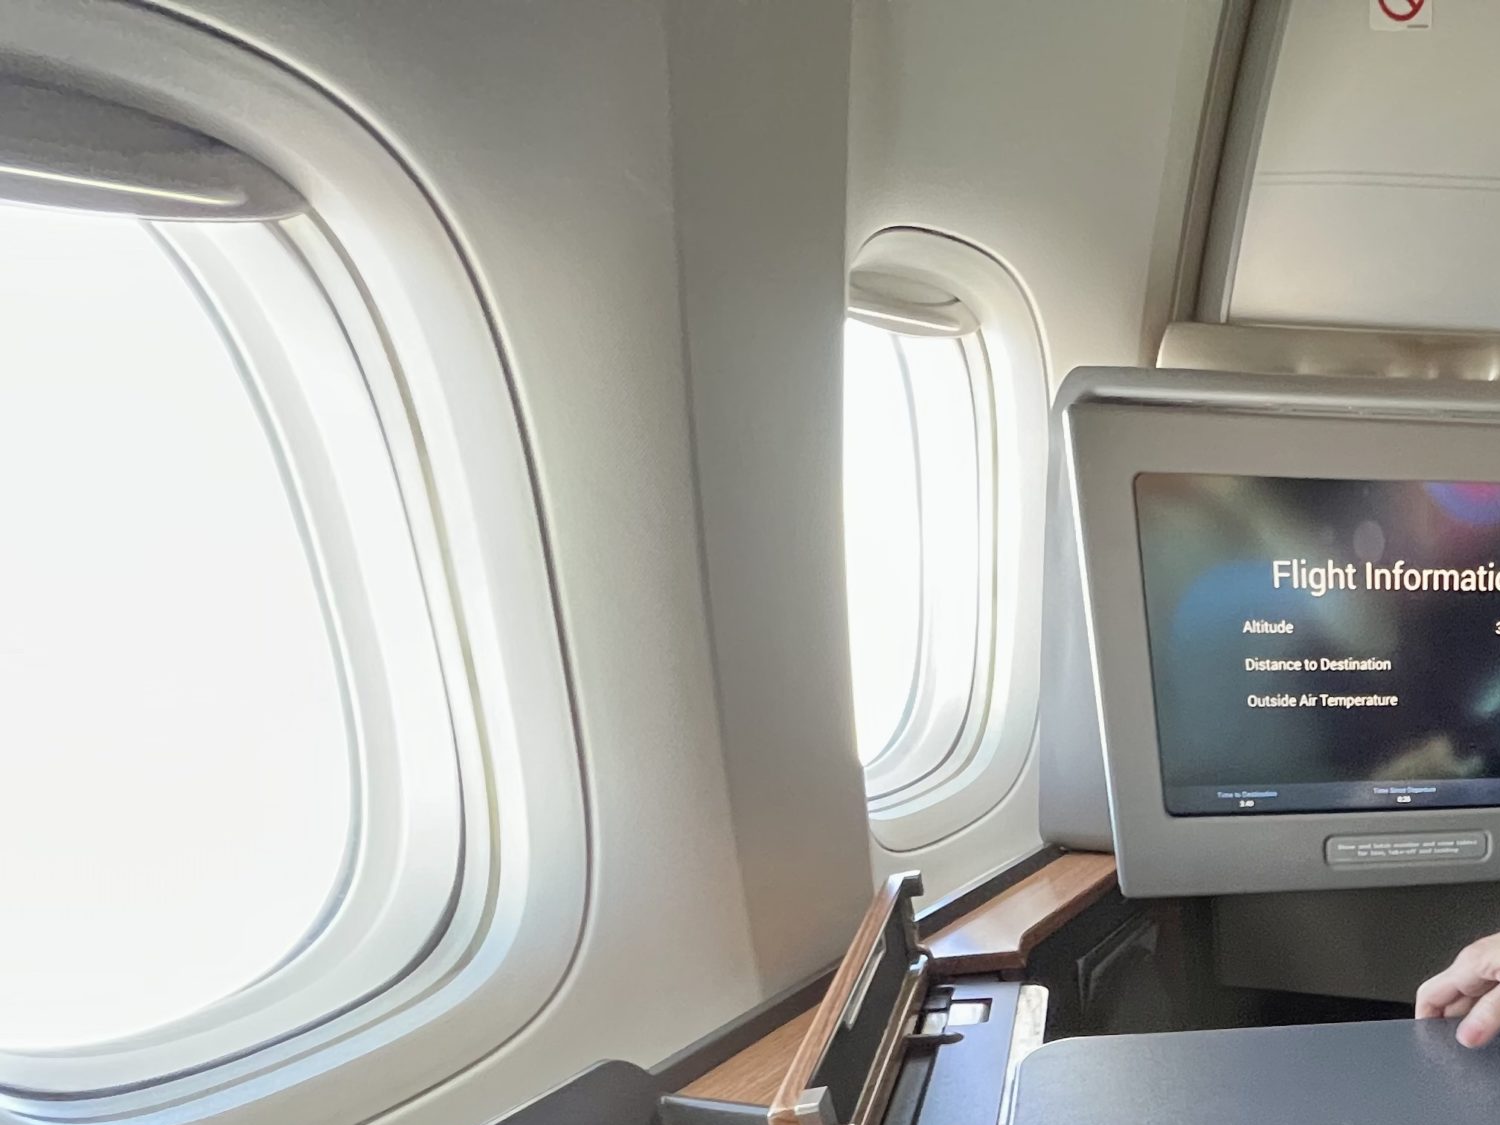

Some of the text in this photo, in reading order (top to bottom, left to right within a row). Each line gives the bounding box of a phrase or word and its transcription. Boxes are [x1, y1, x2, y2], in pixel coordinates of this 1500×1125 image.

[1272, 559, 1357, 597] Flight
[1242, 620, 1294, 634] Altitude
[1245, 657, 1391, 671] Distance to Destination
[1247, 694, 1399, 709] Outside Air Temperature
